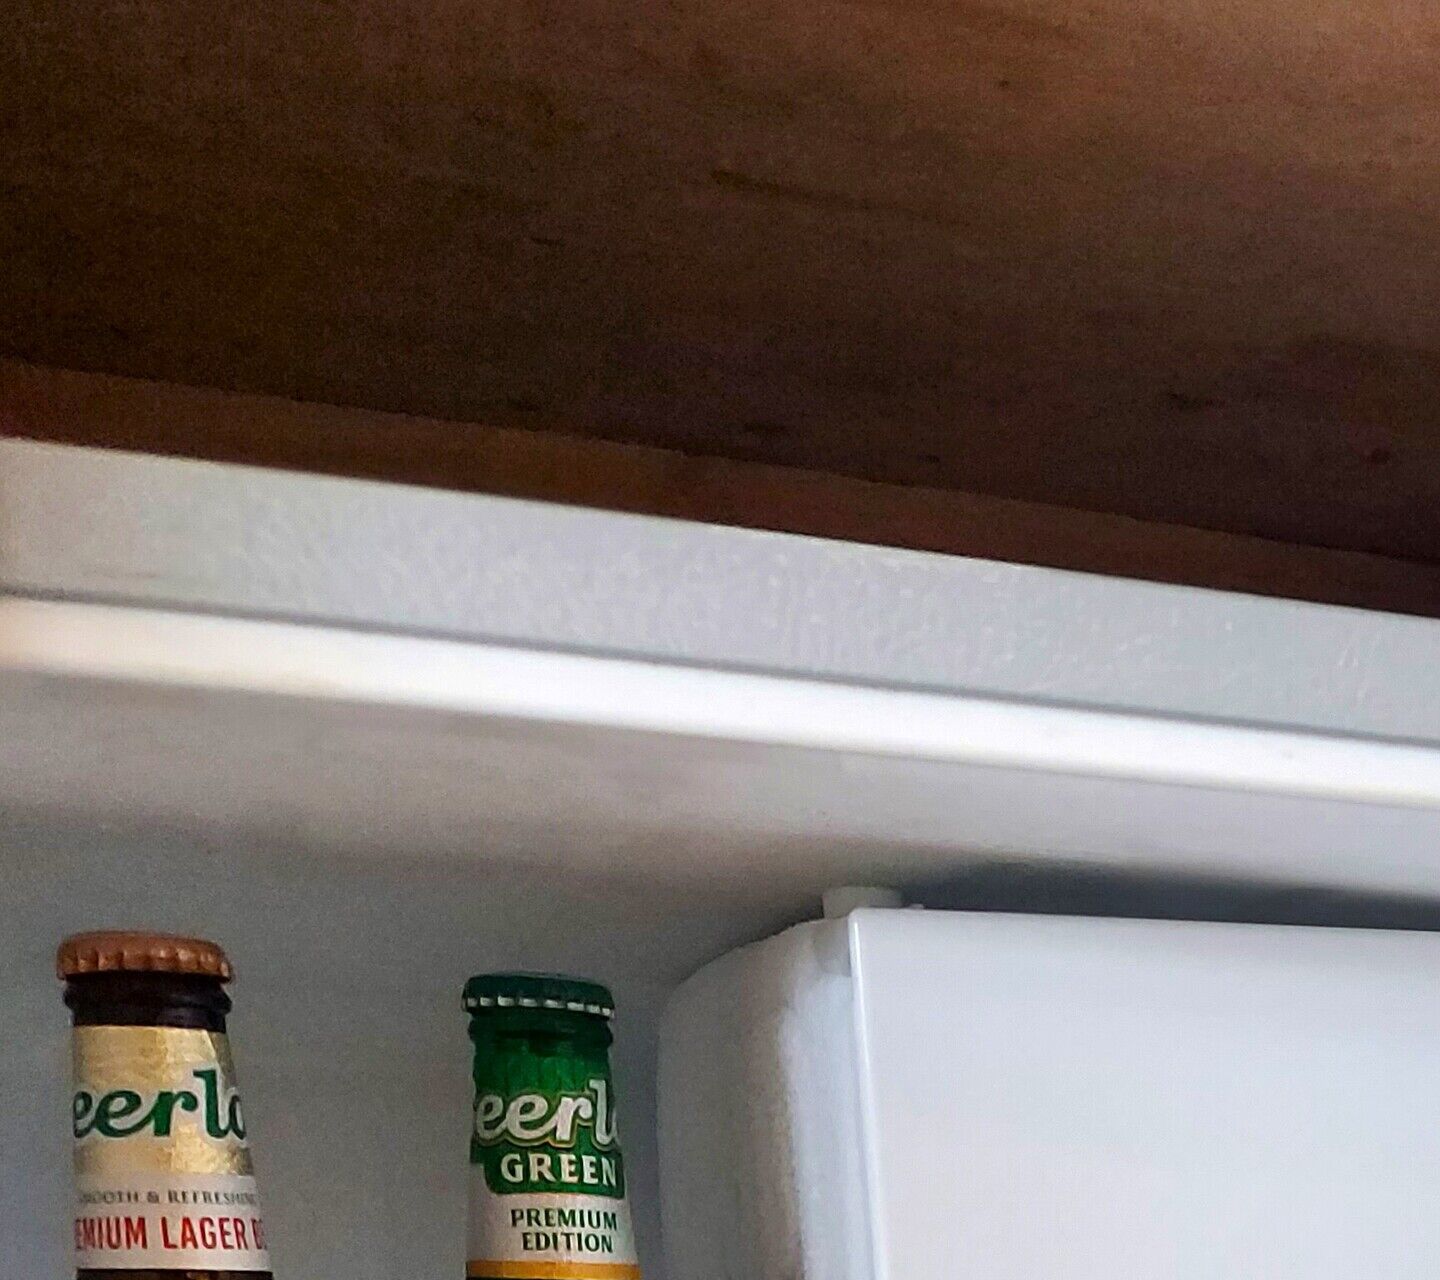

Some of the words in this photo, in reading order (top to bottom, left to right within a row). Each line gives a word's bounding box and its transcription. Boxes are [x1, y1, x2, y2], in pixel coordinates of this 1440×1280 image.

[501, 1152, 617, 1187] GREEN
[160, 1216, 249, 1251] LAGER
[510, 1208, 618, 1232] PREMIUM
[522, 1232, 614, 1254] EDITION
